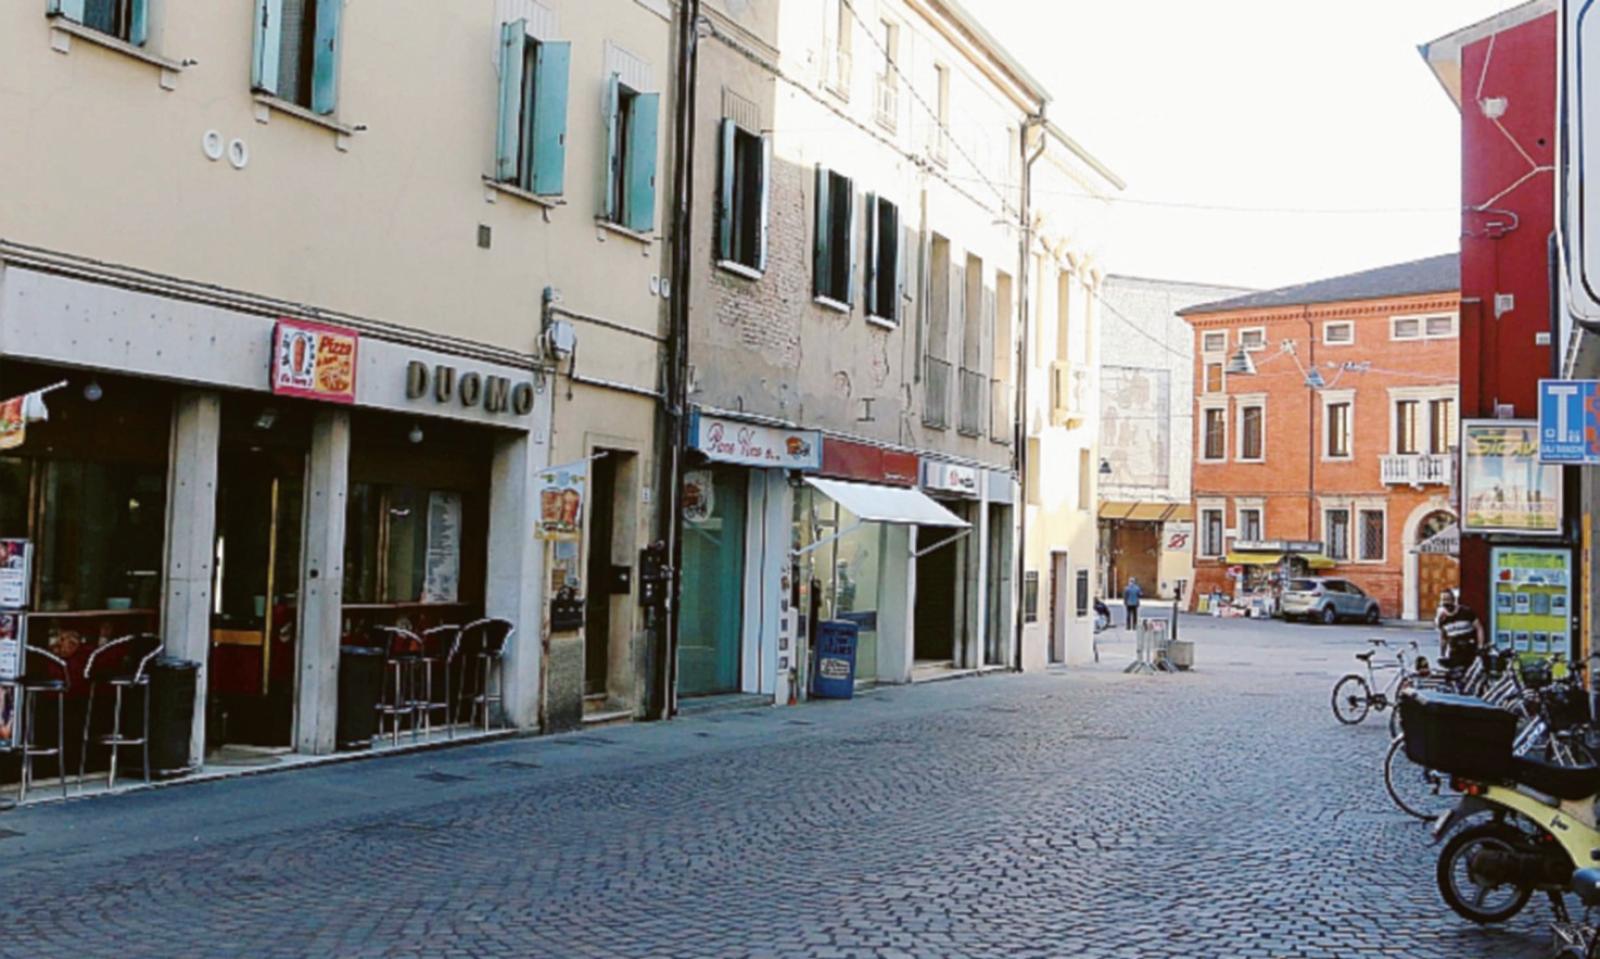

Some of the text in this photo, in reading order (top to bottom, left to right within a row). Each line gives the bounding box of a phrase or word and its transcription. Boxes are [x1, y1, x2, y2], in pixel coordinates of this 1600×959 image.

[319, 335, 352, 356] Pizza
[406, 360, 535, 416] DUOMO
[1547, 385, 1579, 443] T
